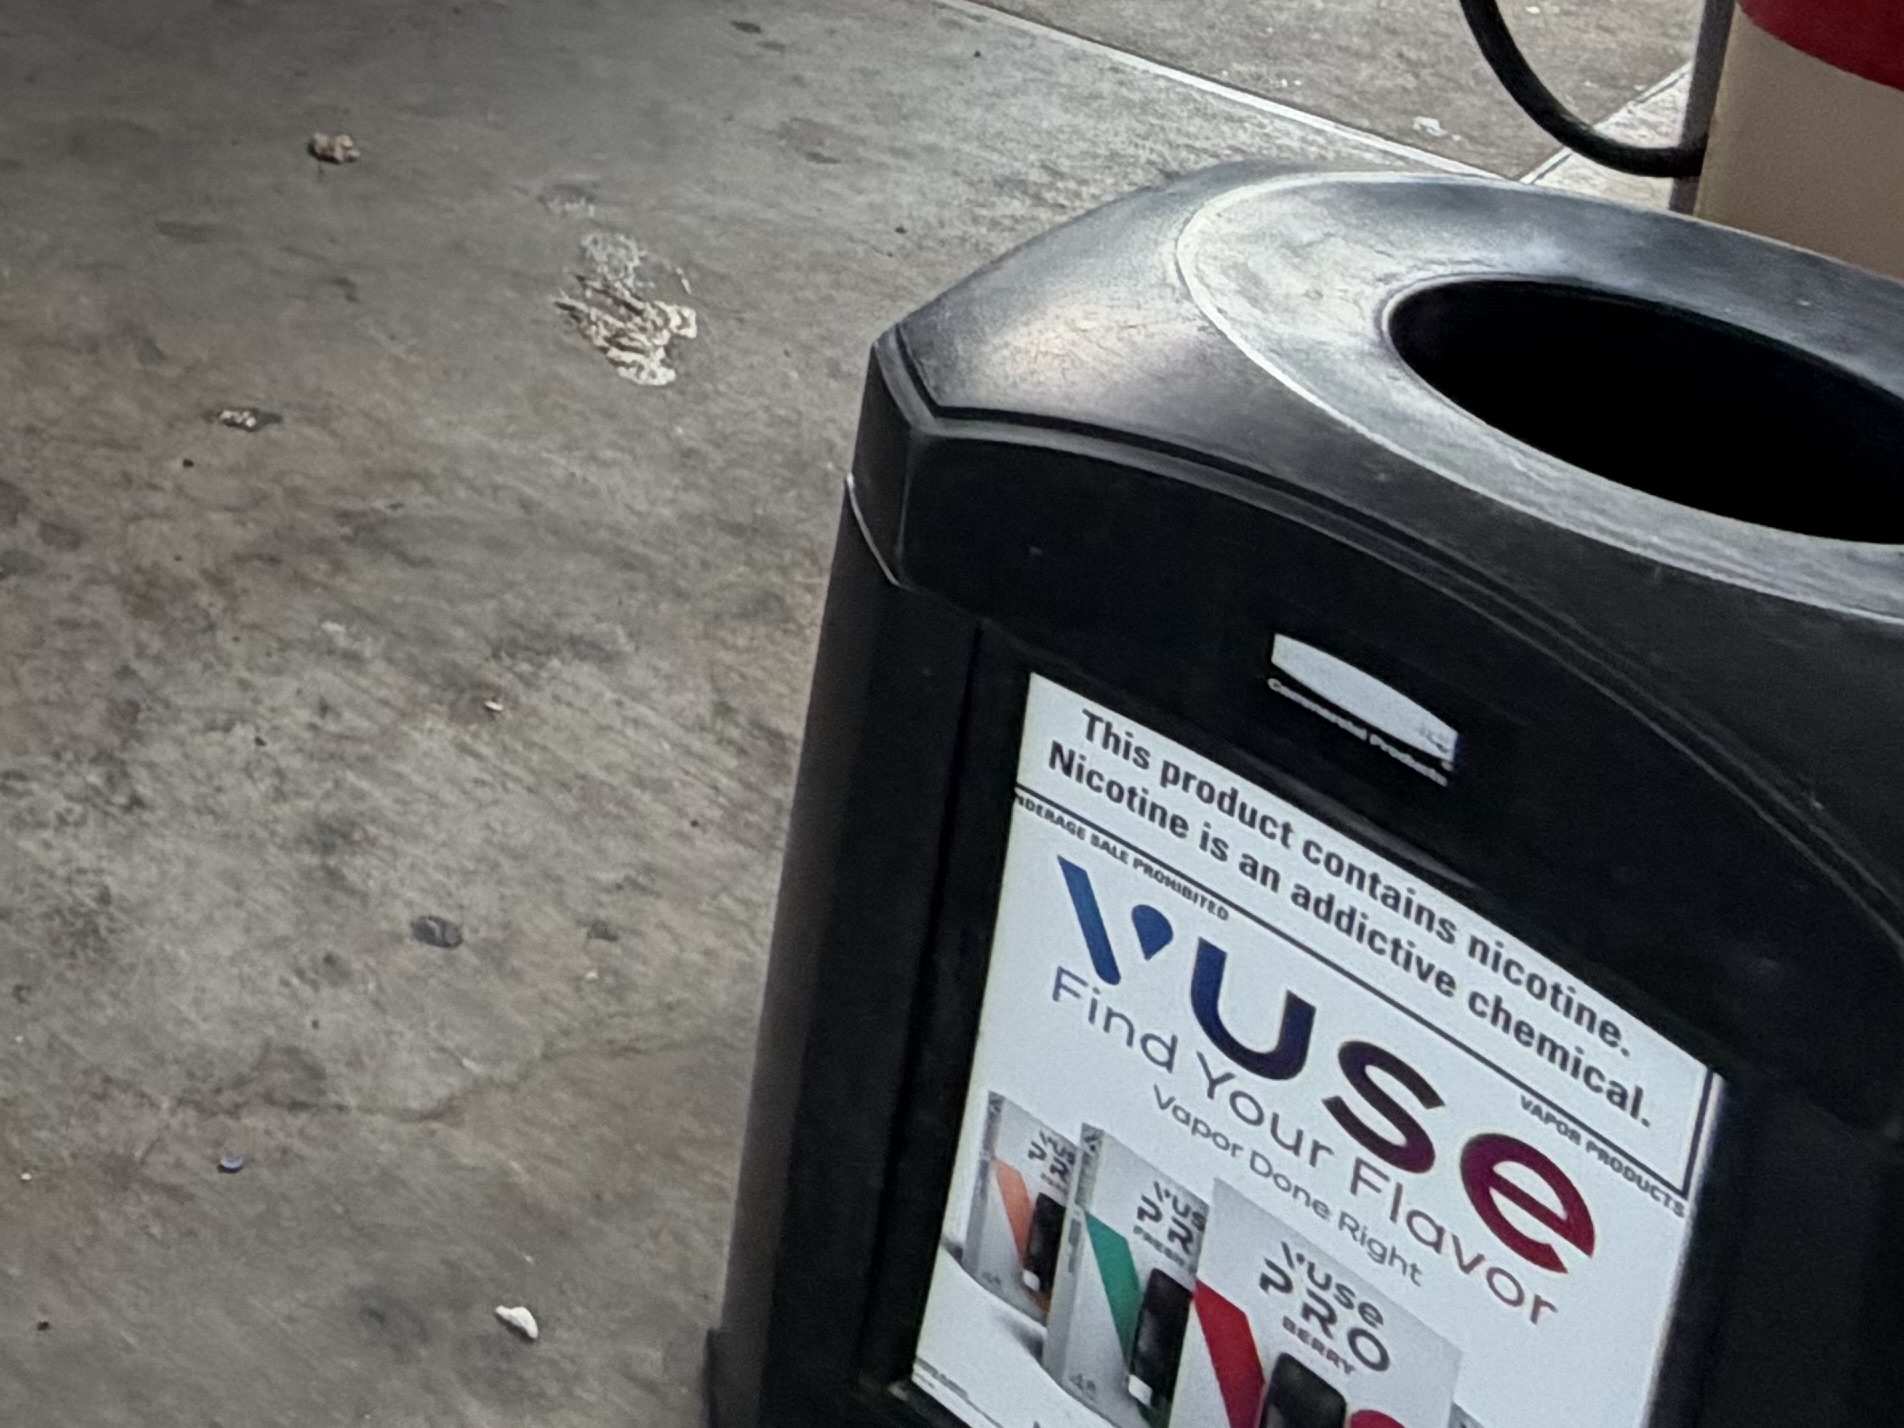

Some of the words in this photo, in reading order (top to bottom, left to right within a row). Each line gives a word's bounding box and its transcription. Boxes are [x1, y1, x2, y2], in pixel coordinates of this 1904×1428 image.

[1048, 739, 1190, 842] Nicotine
[1198, 819, 1231, 865] is
[1238, 850, 1282, 894] an
[1290, 880, 1459, 1000] addictive
[1467, 988, 1652, 1130] chemical.
[1081, 708, 1152, 772] This
[1159, 759, 1296, 851] product
[1302, 838, 1459, 945] contains
[1467, 932, 1632, 1058] nicotine.
[1090, 832, 1130, 866] SALE
[1132, 855, 1230, 922] PROHIBITED
[1051, 965, 1178, 1074] Find
[1196, 1051, 1335, 1169] Your
[1349, 1155, 1559, 1326] Flavor
[1153, 1084, 1245, 1160] Vapor
[1249, 1153, 1331, 1223] Done
[1338, 1213, 1423, 1288] Right
[1519, 1093, 1583, 1147] VAPOR
[1585, 1139, 1687, 1219] PRODUCTS
[1258, 1255, 1391, 1373] PRO
[1281, 1315, 1357, 1378] BERRY
